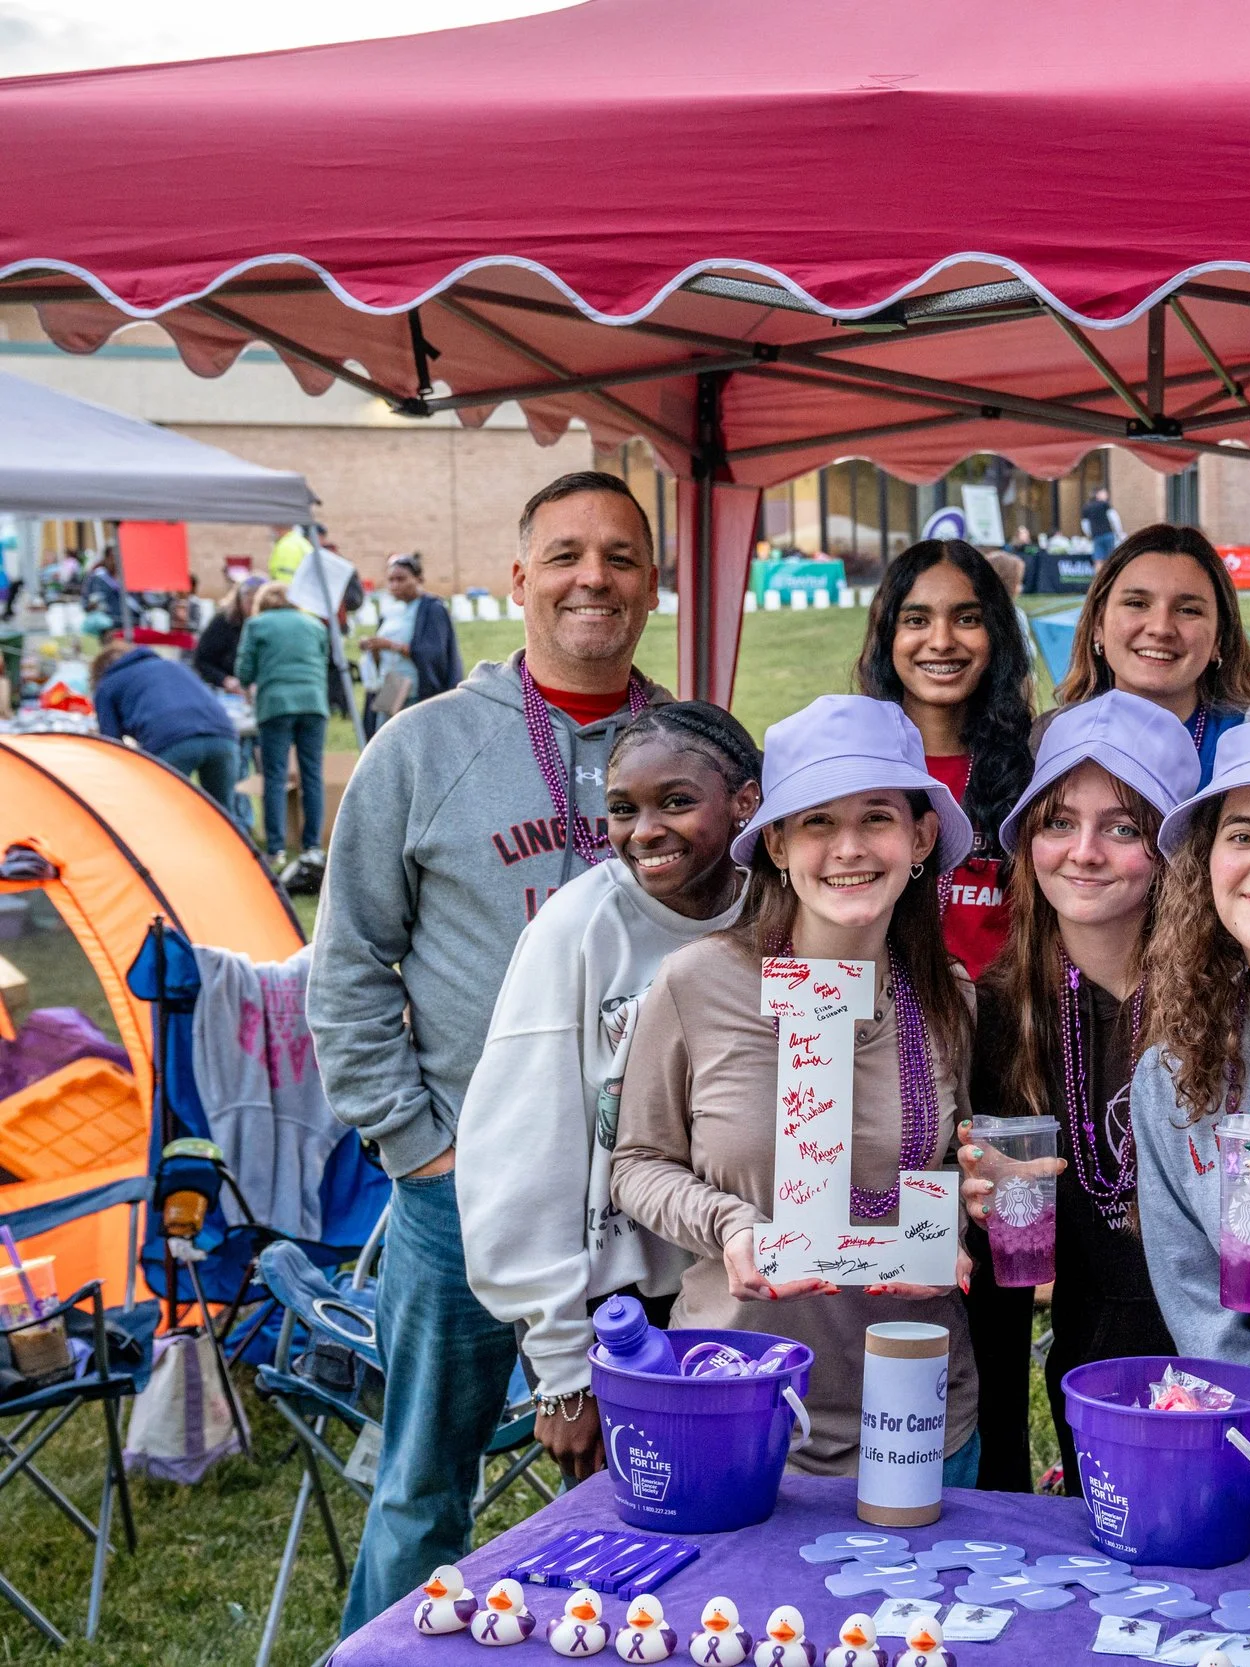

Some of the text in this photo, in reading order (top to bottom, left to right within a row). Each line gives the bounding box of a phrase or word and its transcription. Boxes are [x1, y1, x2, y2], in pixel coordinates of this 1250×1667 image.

[951, 885, 1003, 906] TEAM
[862, 1407, 877, 1429] ers
[880, 1411, 903, 1432] For
[629, 1447, 659, 1460] RELAY
[865, 1446, 884, 1463] Life
[888, 1448, 944, 1465] Radiotho
[630, 1457, 672, 1472] FOR LIFE
[641, 1478, 665, 1486] American
[1089, 1475, 1115, 1493] RELAY
[642, 1487, 659, 1495] Society
[1091, 1486, 1129, 1506] FOR LIFE
[1101, 1510, 1123, 1521] American
